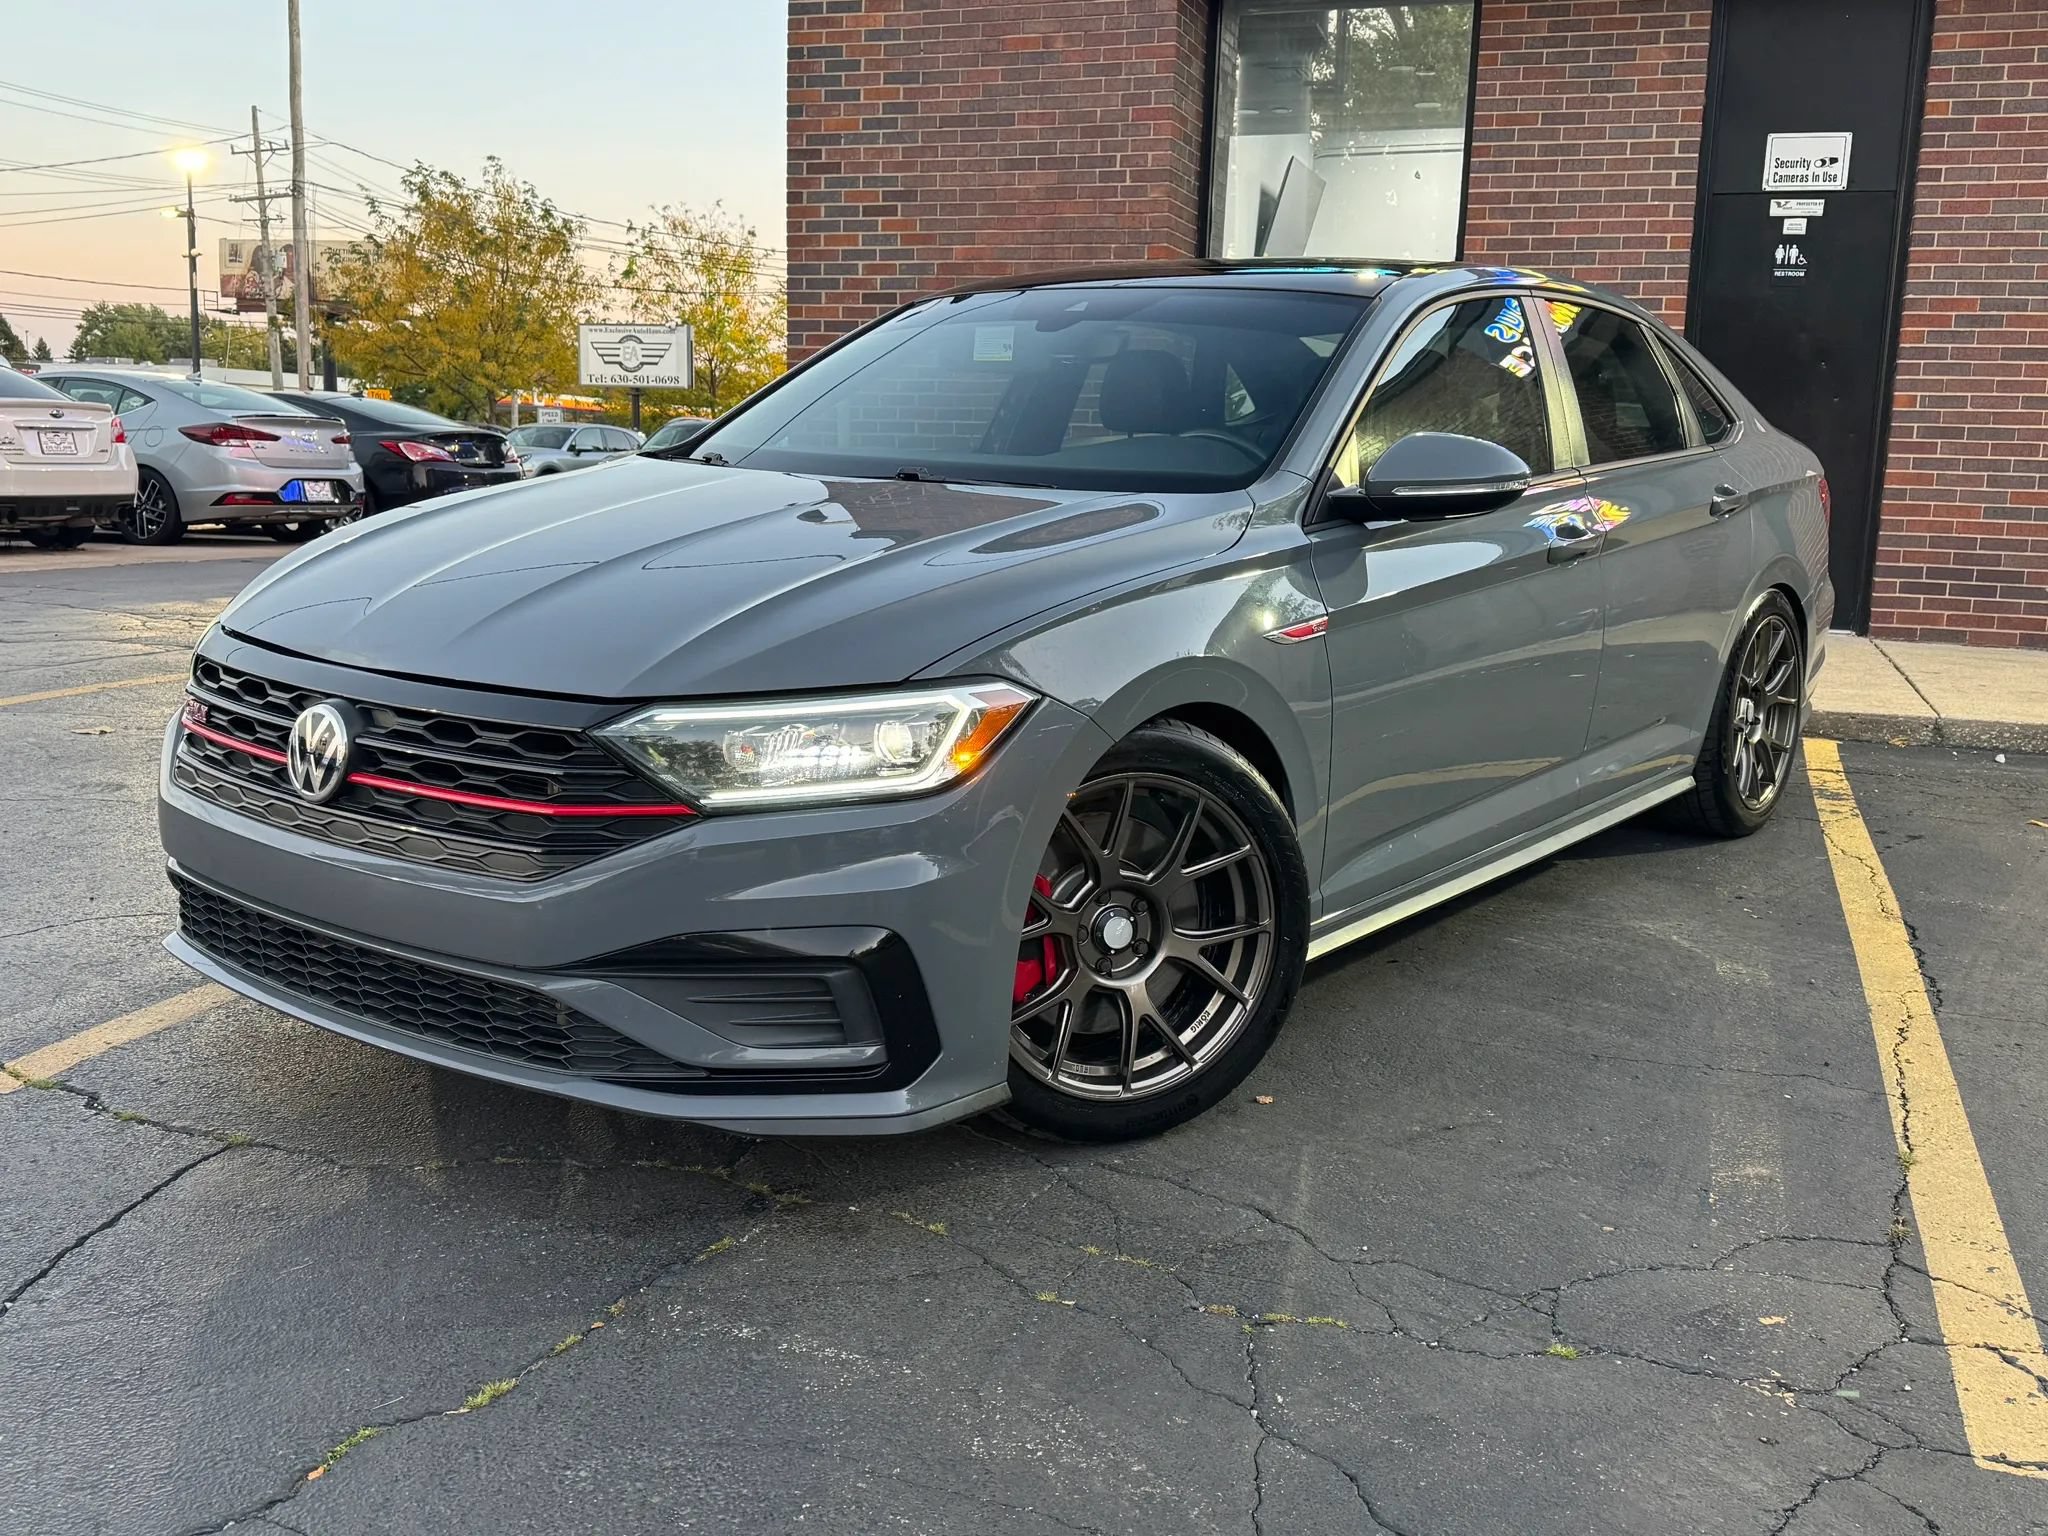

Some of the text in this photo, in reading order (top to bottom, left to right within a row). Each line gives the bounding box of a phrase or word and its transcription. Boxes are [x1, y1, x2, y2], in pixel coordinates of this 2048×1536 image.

[1774, 157, 1812, 171] Security
[1772, 171, 1838, 183] Cameras In Use
[623, 345, 639, 361] EA
[587, 374, 680, 385] Tel: 630-501-0698
